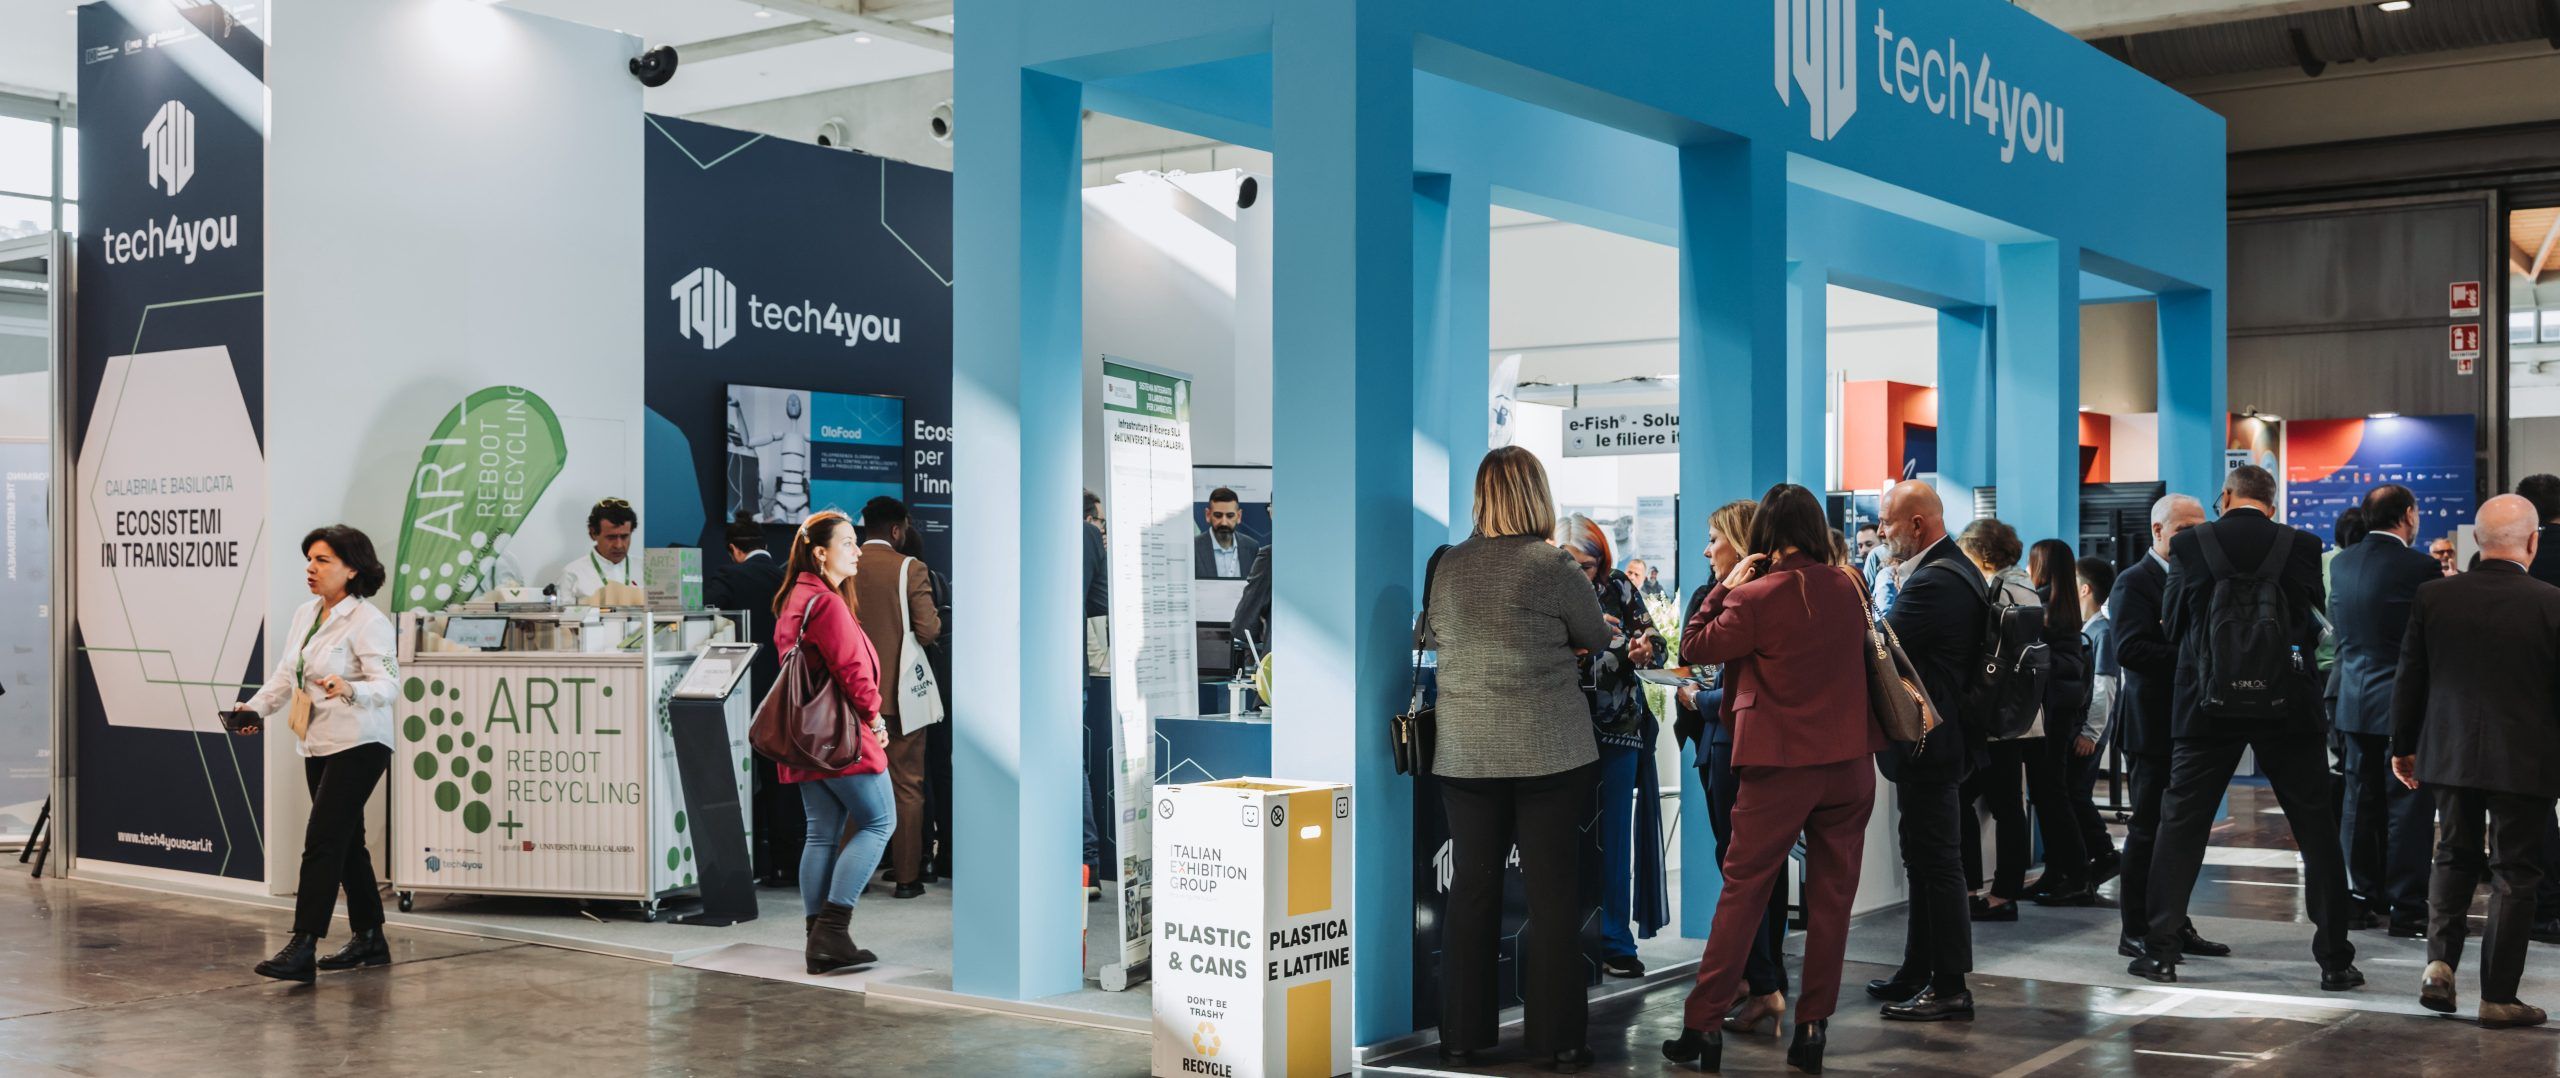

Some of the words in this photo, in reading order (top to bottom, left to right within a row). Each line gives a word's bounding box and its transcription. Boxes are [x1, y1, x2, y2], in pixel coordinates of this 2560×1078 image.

[1874, 8, 2064, 164] tech4you
[103, 214, 238, 265] tech4you
[748, 294, 901, 347] tech4you
[821, 425, 862, 439] OloFood
[1596, 434, 1611, 447] le
[1616, 432, 1665, 446] filiere
[502, 385, 527, 517] RECYCLING
[914, 450, 944, 470] per
[476, 418, 500, 517] REBOOT
[105, 478, 158, 497] CALABRIA
[161, 477, 168, 495] E
[170, 475, 234, 494] BASILICATA
[116, 508, 222, 536] ECOSISTEMI
[101, 542, 117, 568] IN
[122, 541, 238, 568] TRANSIZIONE
[507, 750, 601, 774] REBOOT
[507, 779, 641, 805] RECYCLING
[117, 831, 213, 853] www.tech4youscarl.it
[1170, 844, 1221, 861] ITALIAN
[443, 859, 483, 870] tech4you
[1170, 861, 1247, 880] EXHIBITION
[1170, 876, 1217, 892] GROUP
[1164, 921, 1251, 950] PLASTIC
[1269, 918, 1348, 951] PLASTICA
[1168, 951, 1183, 971] &
[1190, 954, 1247, 979] CANS
[1268, 961, 1278, 981] E
[1284, 946, 1350, 978] LATTINE
[1187, 995, 1213, 1007] DON'T
[1216, 1000, 1227, 1009] BE
[1190, 1007, 1224, 1020] TRASHY
[1182, 1057, 1231, 1078] RECYCLE
